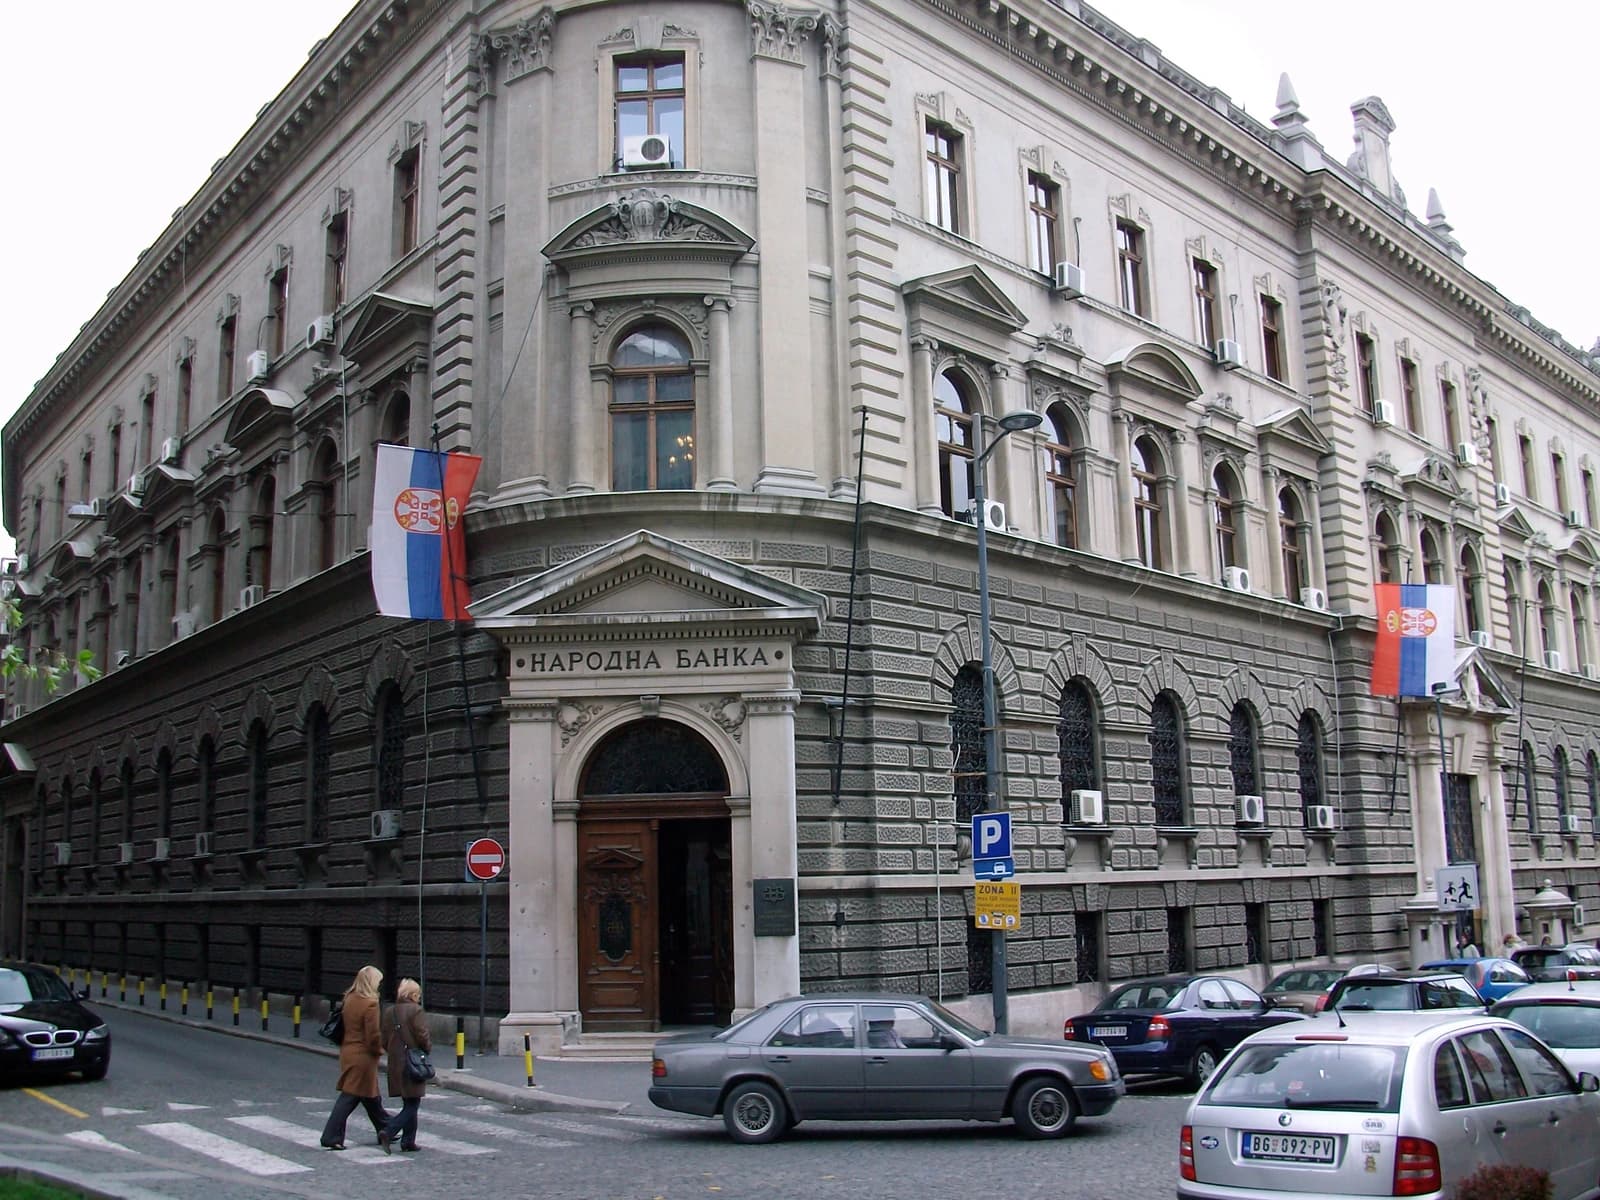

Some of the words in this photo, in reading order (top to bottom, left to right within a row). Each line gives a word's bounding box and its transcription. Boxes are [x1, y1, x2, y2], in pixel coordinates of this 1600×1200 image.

[530, 649, 662, 673] НАРОДНА
[676, 647, 769, 669] БАНКА
[980, 819, 1002, 854] P
[978, 885, 1005, 894] ZONA
